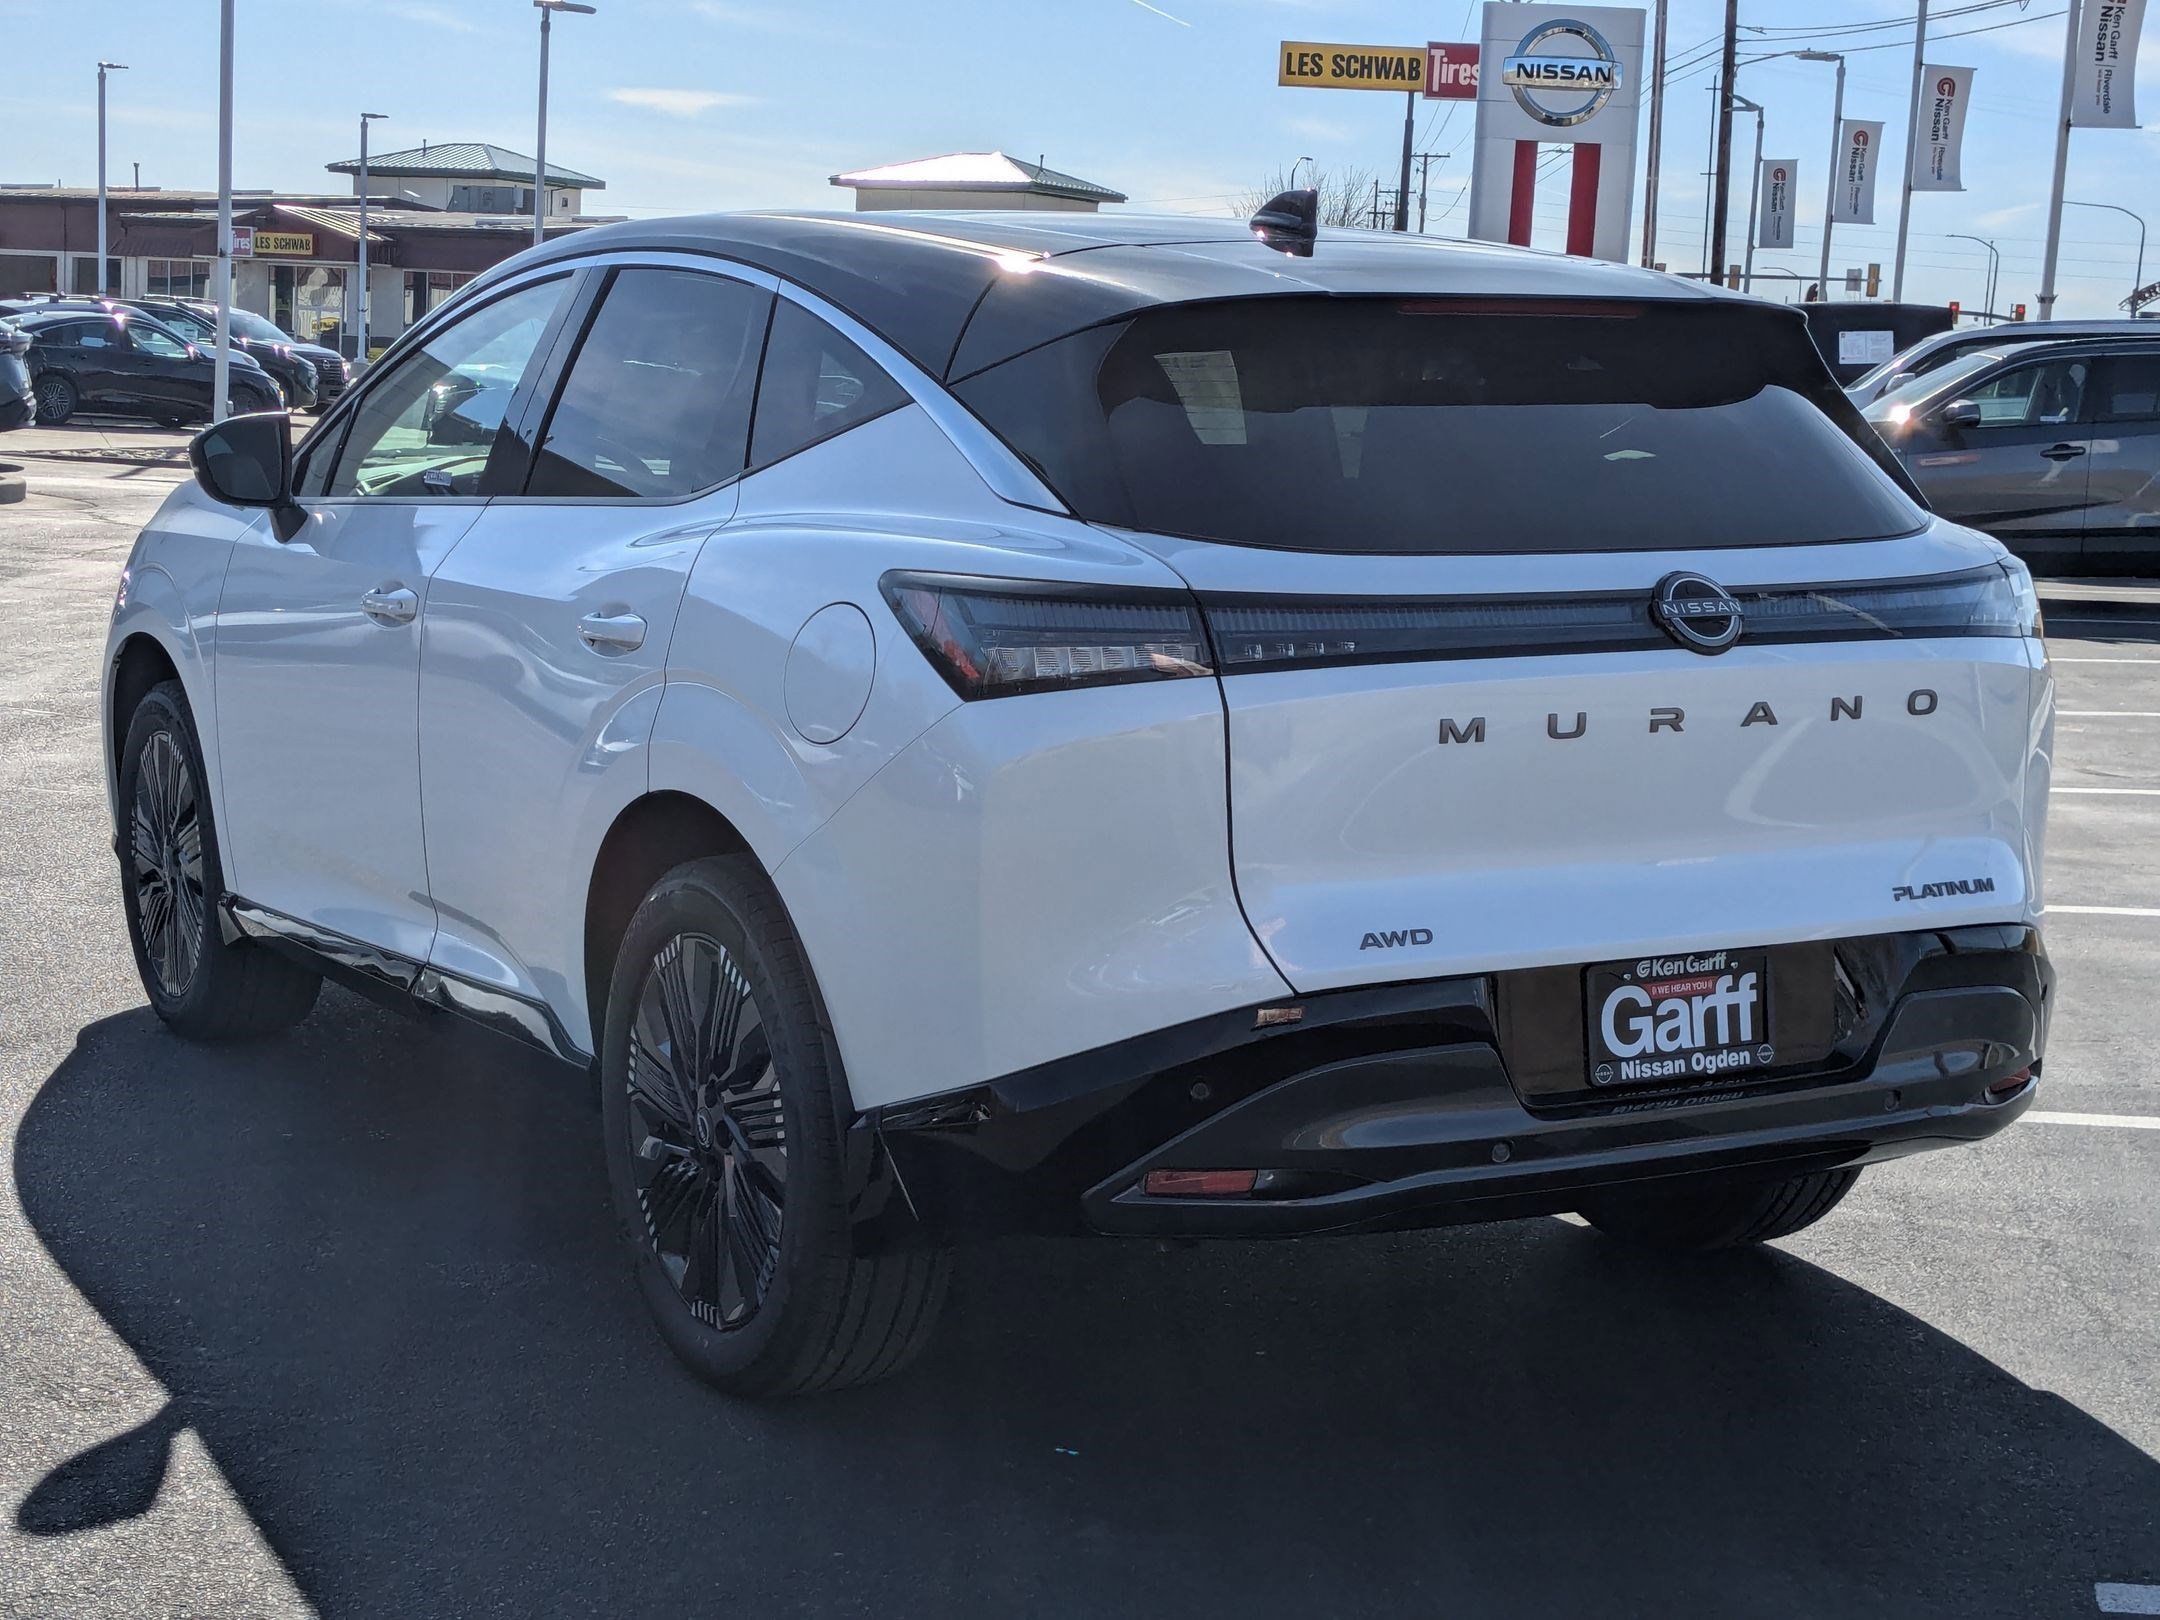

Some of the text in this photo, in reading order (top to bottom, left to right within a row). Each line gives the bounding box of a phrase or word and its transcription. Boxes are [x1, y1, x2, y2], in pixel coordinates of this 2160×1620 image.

[2112, 6, 2125, 29] Ken
[2095, 6, 2114, 62] Nissan
[1286, 52, 1421, 81] LES SCHWAB
[1430, 49, 1480, 92] Tires
[1516, 63, 1612, 82] NISSAN
[2103, 69, 2113, 114] Riverdale
[1931, 98, 1945, 142] Nissan
[232, 230, 251, 249] ires
[255, 237, 311, 251] LES SCHWAB
[1662, 601, 1742, 615] NISSAN
[1438, 688, 1938, 745] MURANO
[1892, 878, 1995, 901] PLATINUM
[1360, 929, 1433, 950] AWD
[1652, 952, 1727, 977] Ken Garff
[1658, 980, 1707, 994] WE HEAR YOU
[1601, 972, 1757, 1058] Garff
[1621, 1050, 1751, 1080] Nissan Ogden
